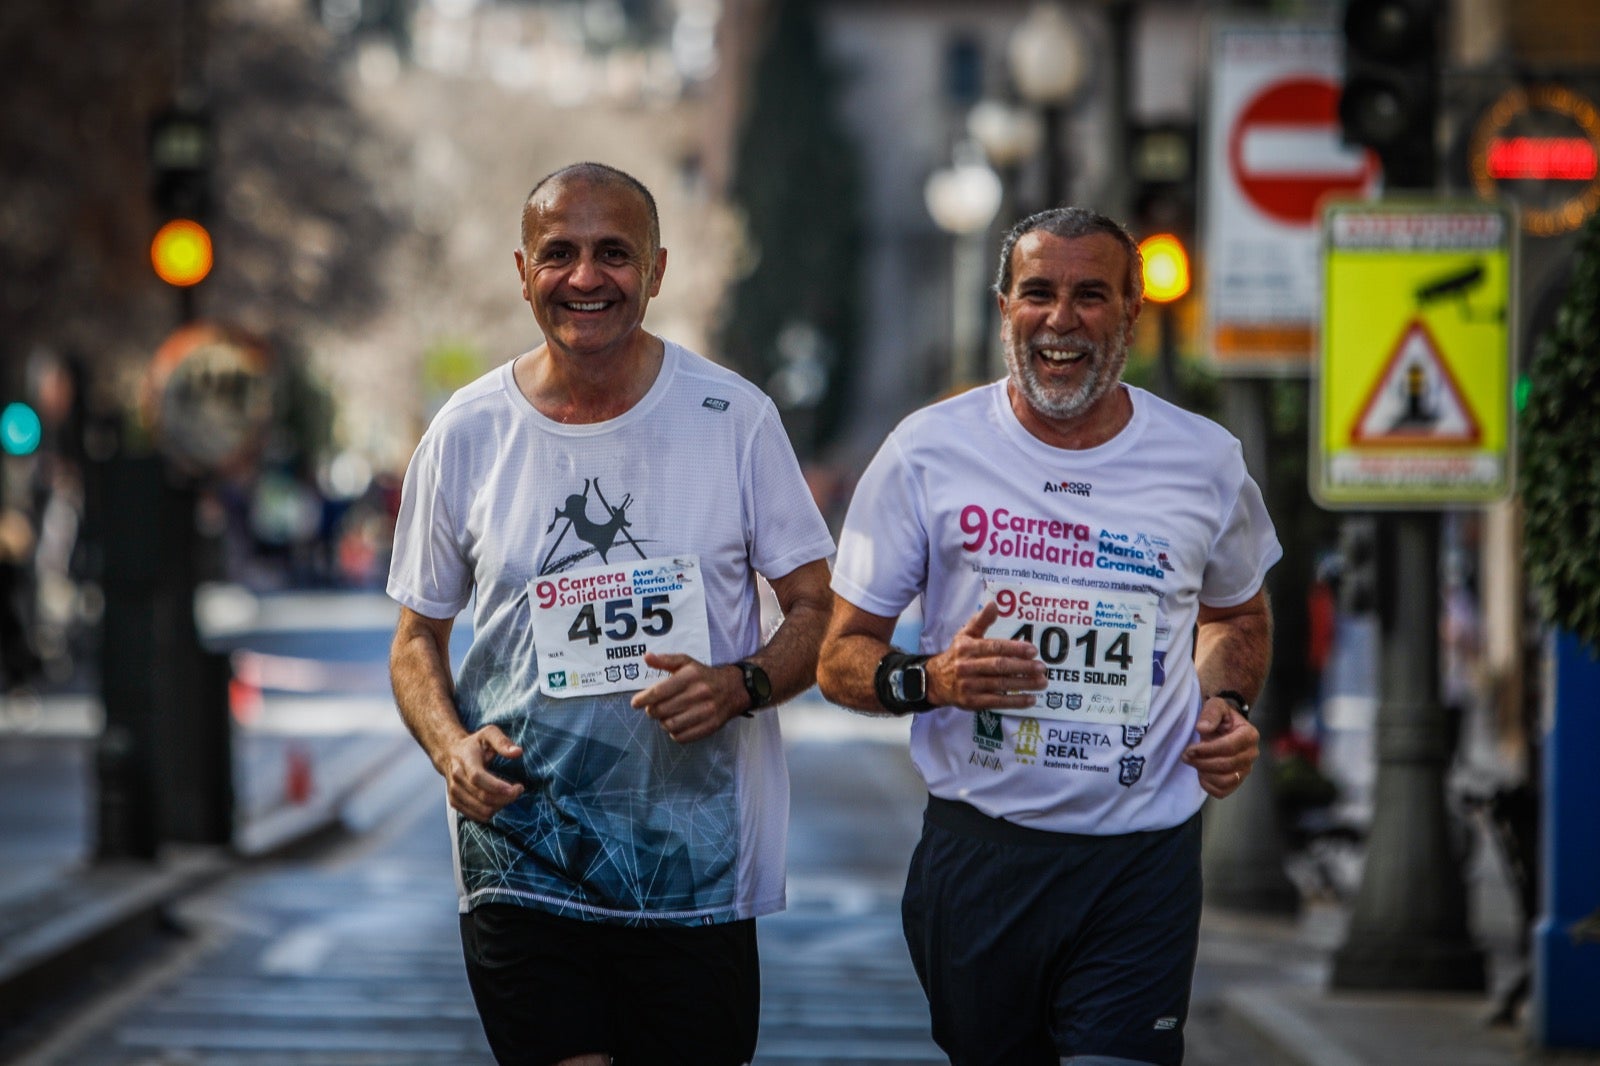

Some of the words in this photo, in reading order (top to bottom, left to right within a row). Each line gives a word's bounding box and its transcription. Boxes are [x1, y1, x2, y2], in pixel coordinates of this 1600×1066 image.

[960, 505, 988, 553] 9
[992, 508, 1090, 541] Carrera
[1100, 529, 1128, 542] Ave
[989, 531, 1094, 568] Solidaria
[1099, 541, 1144, 560] María
[632, 569, 653, 578] Ave
[1096, 556, 1164, 579] Granada
[558, 572, 626, 592] Carrera
[633, 575, 665, 587] María
[634, 583, 683, 595] Granada
[1062, 576, 1069, 585] el
[1071, 577, 1110, 590] esfuerzo
[536, 580, 557, 609] 9
[559, 585, 632, 607] Solidaria
[996, 589, 1017, 617] 9
[1019, 591, 1089, 611] Carrera
[1096, 601, 1115, 610] Ave
[568, 594, 673, 645] 455
[1017, 606, 1092, 626] Solidaria
[1094, 620, 1137, 630] Granada
[606, 644, 646, 660] ROBER
[1046, 668, 1080, 683] ETES
[1048, 729, 1111, 747] PUERTA
[1046, 744, 1089, 760] REAL
[1044, 760, 1071, 769] Academia
[1072, 762, 1079, 770] de
